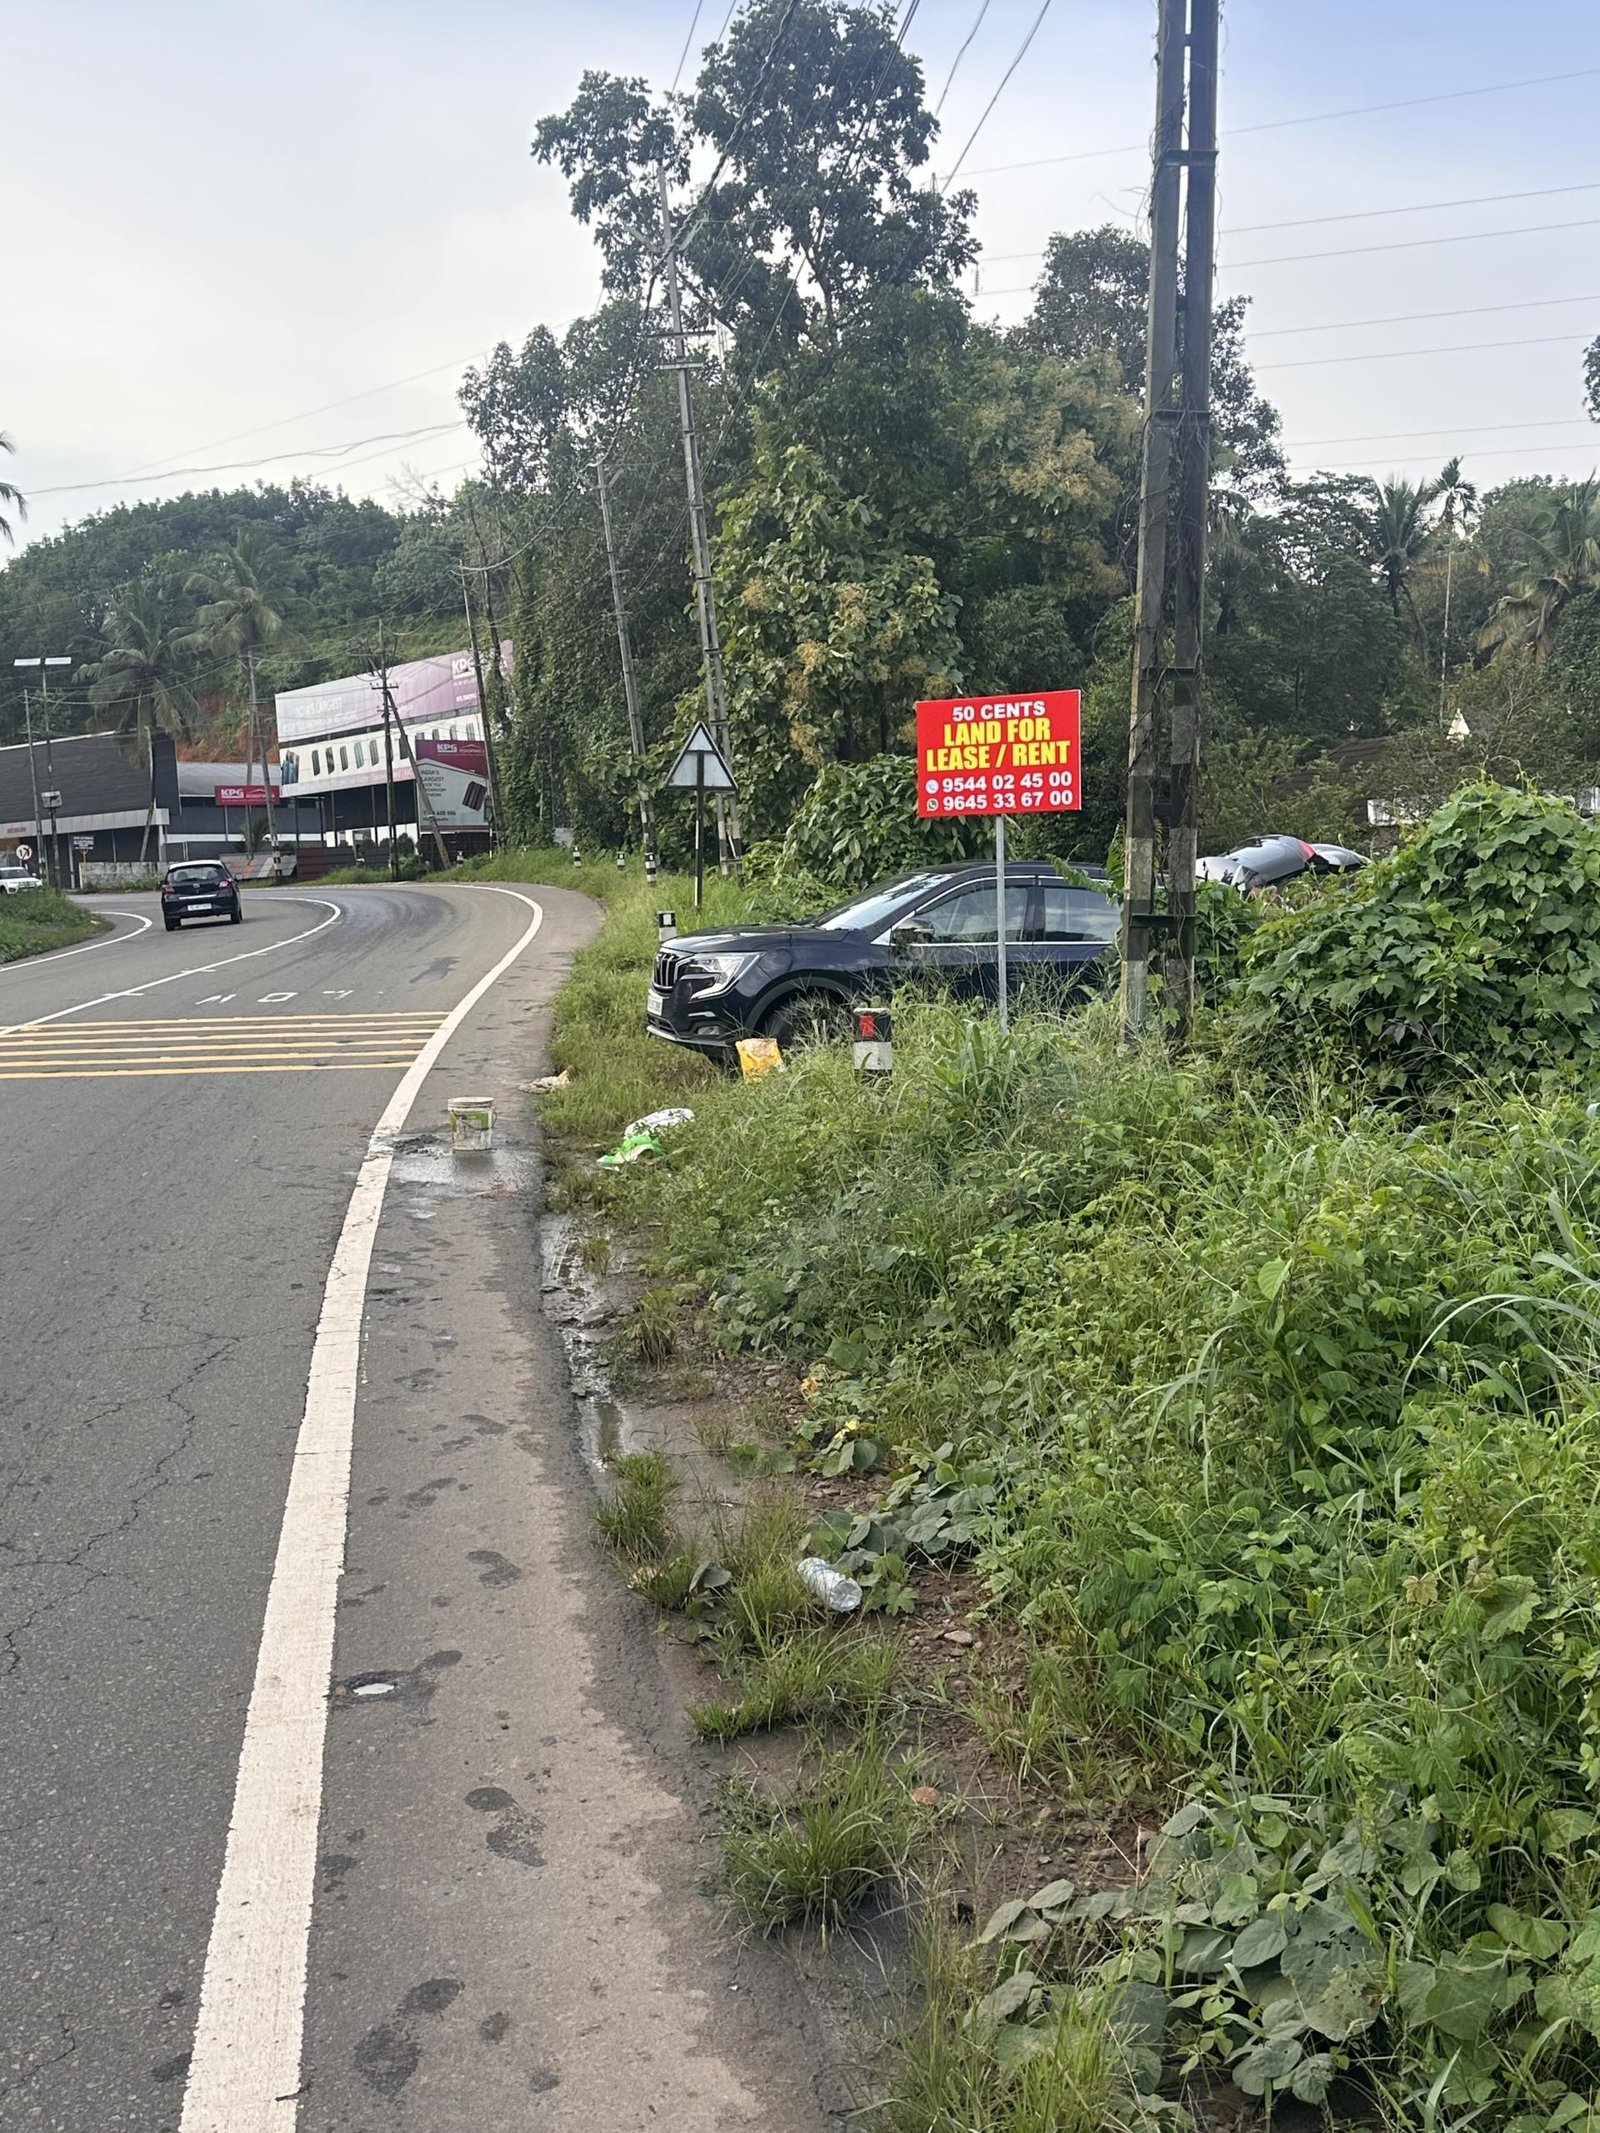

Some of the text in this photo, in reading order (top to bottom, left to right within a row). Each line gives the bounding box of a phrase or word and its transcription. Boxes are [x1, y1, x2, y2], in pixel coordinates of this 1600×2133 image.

[952, 700, 1046, 722] 50 CENTS
[943, 717, 1051, 747] LAND FOR
[926, 744, 991, 772] LEASE
[1012, 740, 1071, 767] RENT
[942, 771, 1073, 793] 9544 02 45 00
[220, 788, 245, 799] KPG
[943, 790, 1073, 812] 9645 33 67 00
